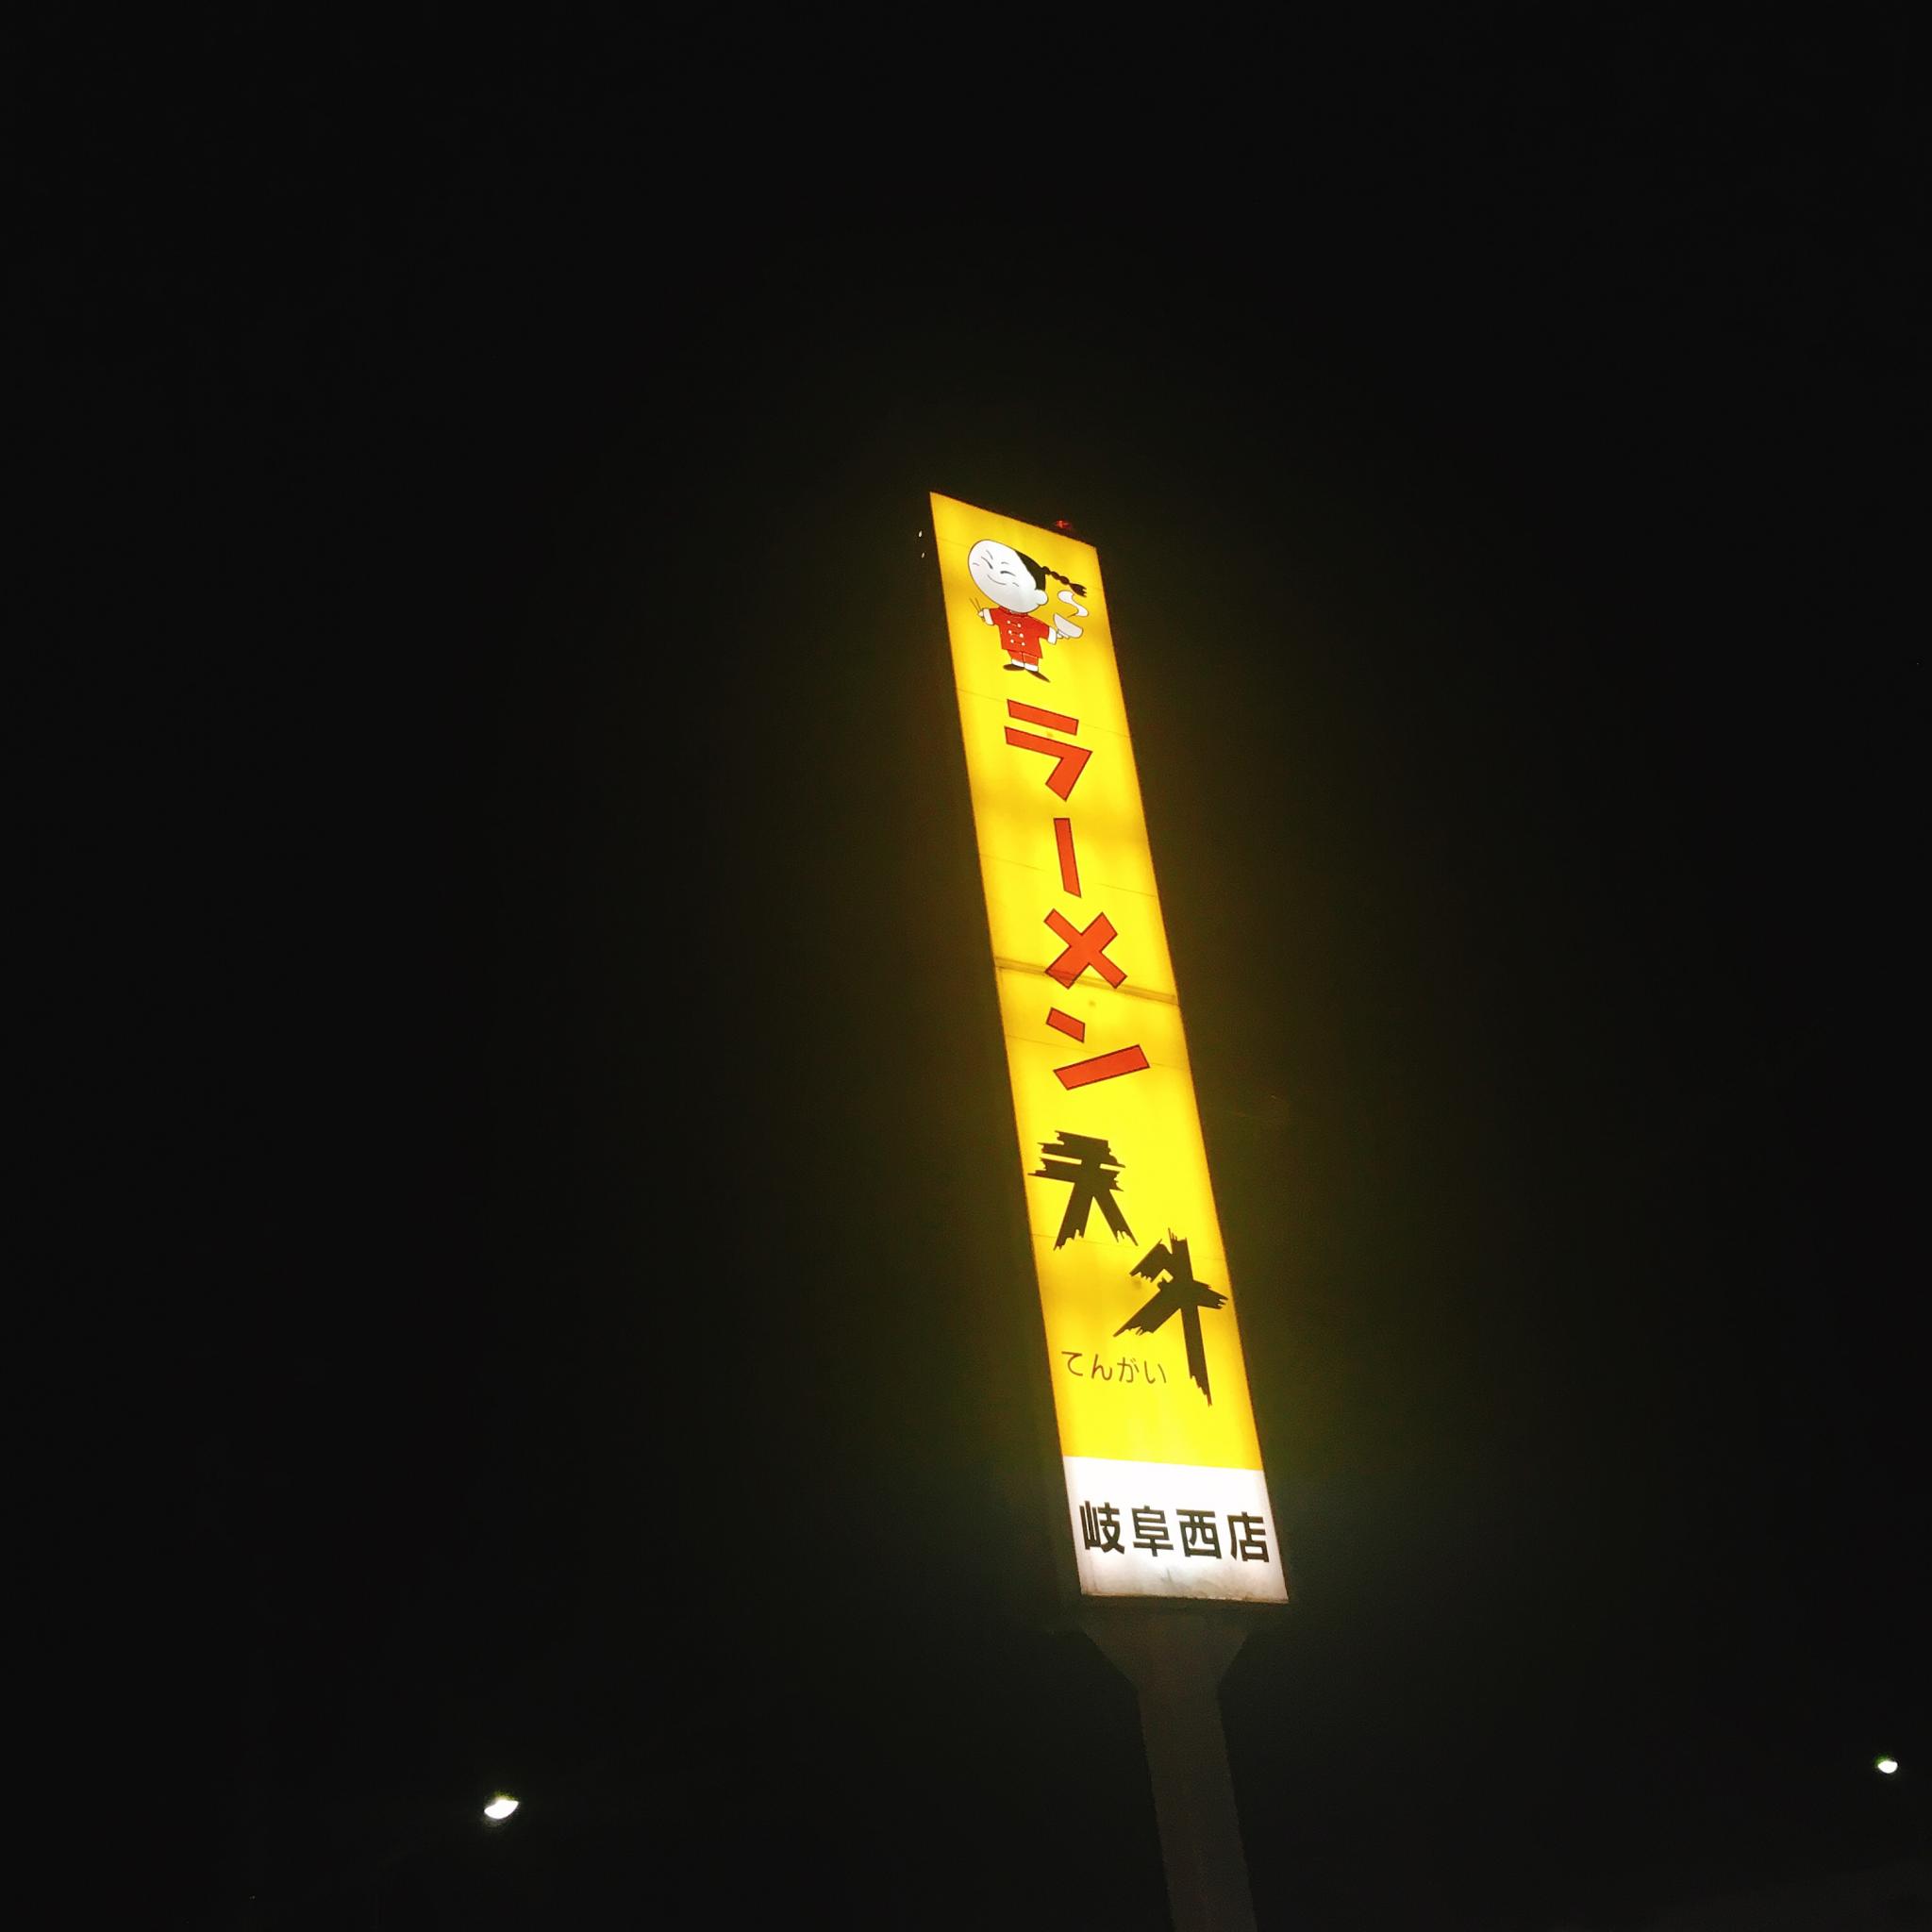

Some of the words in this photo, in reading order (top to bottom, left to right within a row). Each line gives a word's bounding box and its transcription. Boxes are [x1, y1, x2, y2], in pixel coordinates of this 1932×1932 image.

[1005, 699, 1150, 1090] ラーメン
[1061, 1350, 1167, 1385] てんがい
[1079, 1501, 1270, 1563] 岐阜西店
